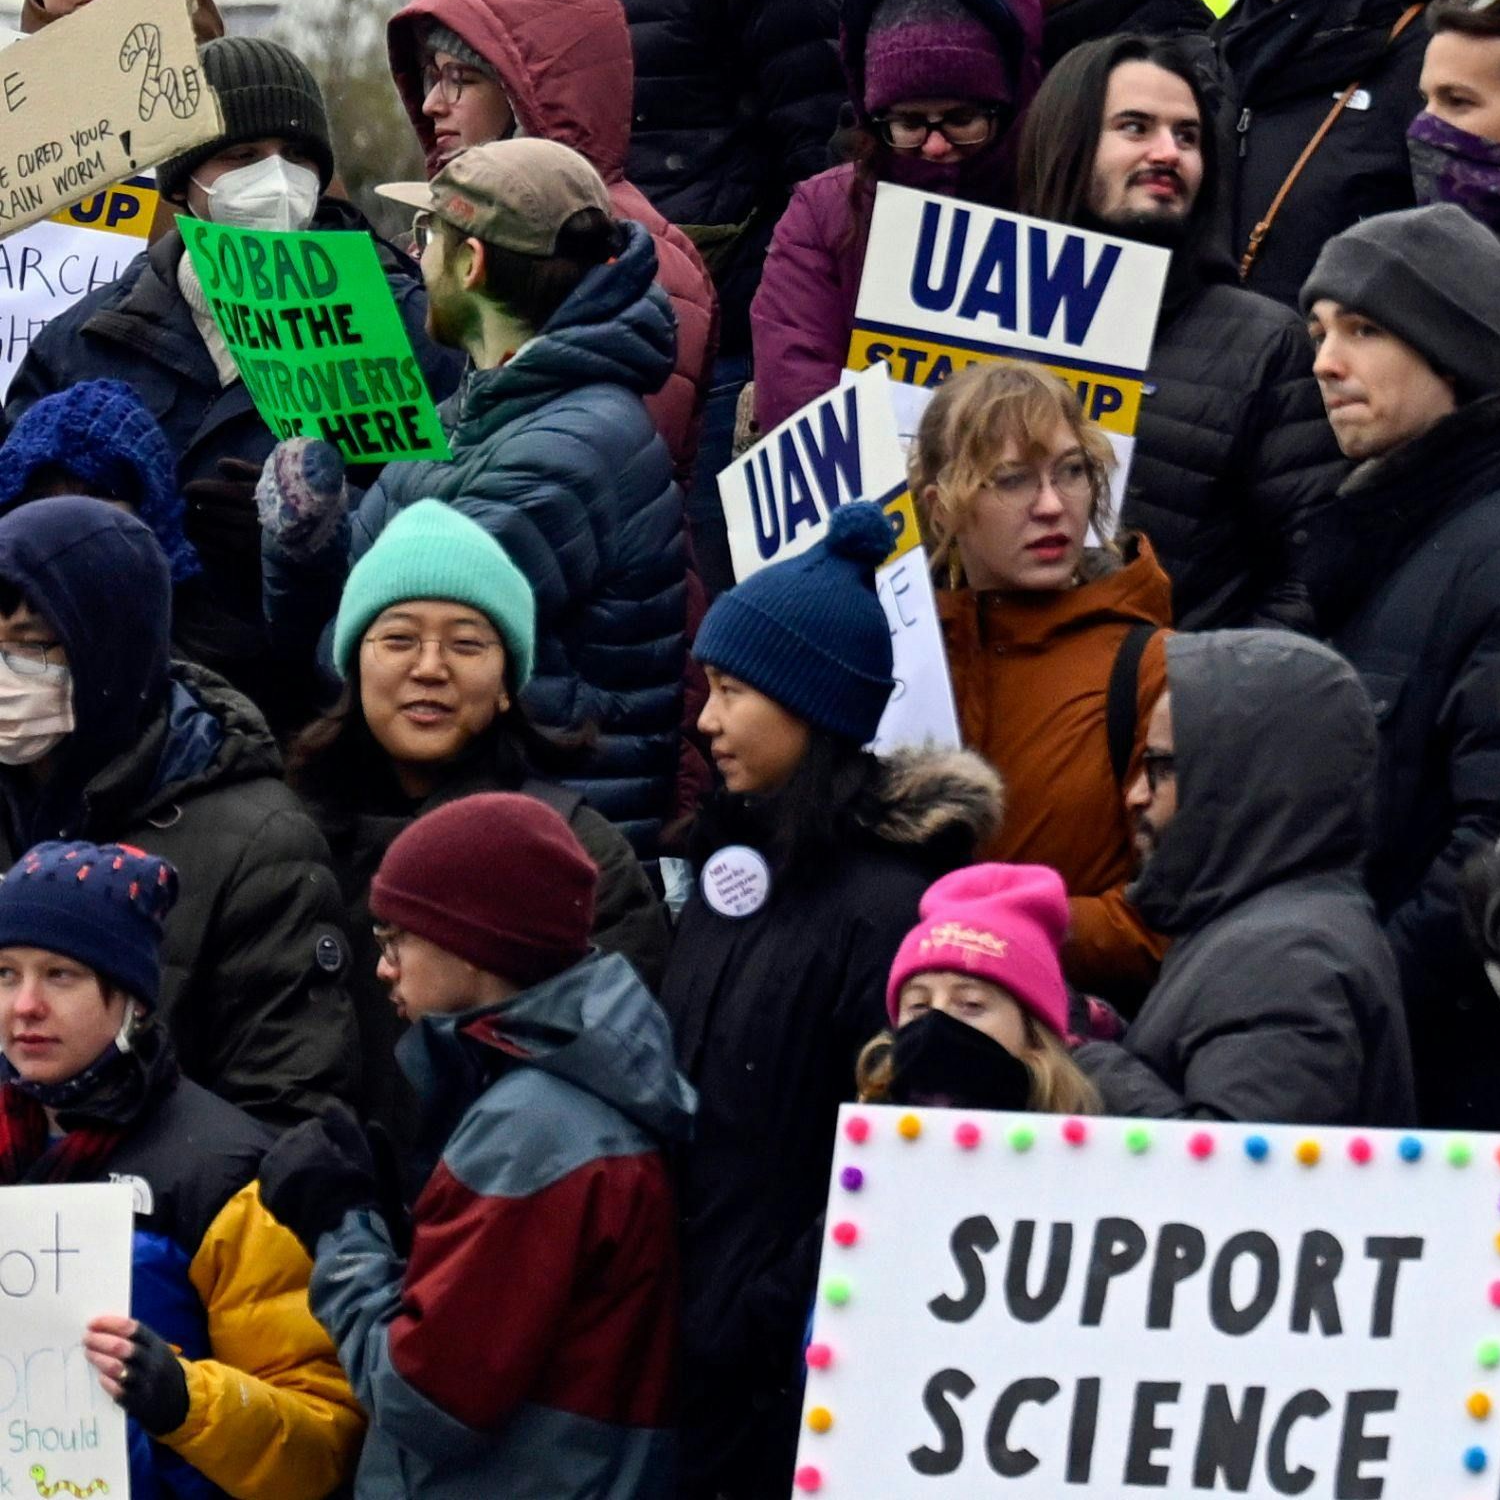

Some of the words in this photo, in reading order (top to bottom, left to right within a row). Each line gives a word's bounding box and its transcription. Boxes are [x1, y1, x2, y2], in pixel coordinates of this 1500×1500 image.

[17, 141, 63, 178] CURED
[70, 119, 113, 152] YOUR
[52, 151, 106, 195] WORM
[910, 201, 1122, 348] UAW
[317, 405, 432, 456] HERE
[742, 385, 862, 560] UAW
[927, 1214, 1424, 1339] SUPPORT
[907, 1367, 1399, 1500] SCIENCE
